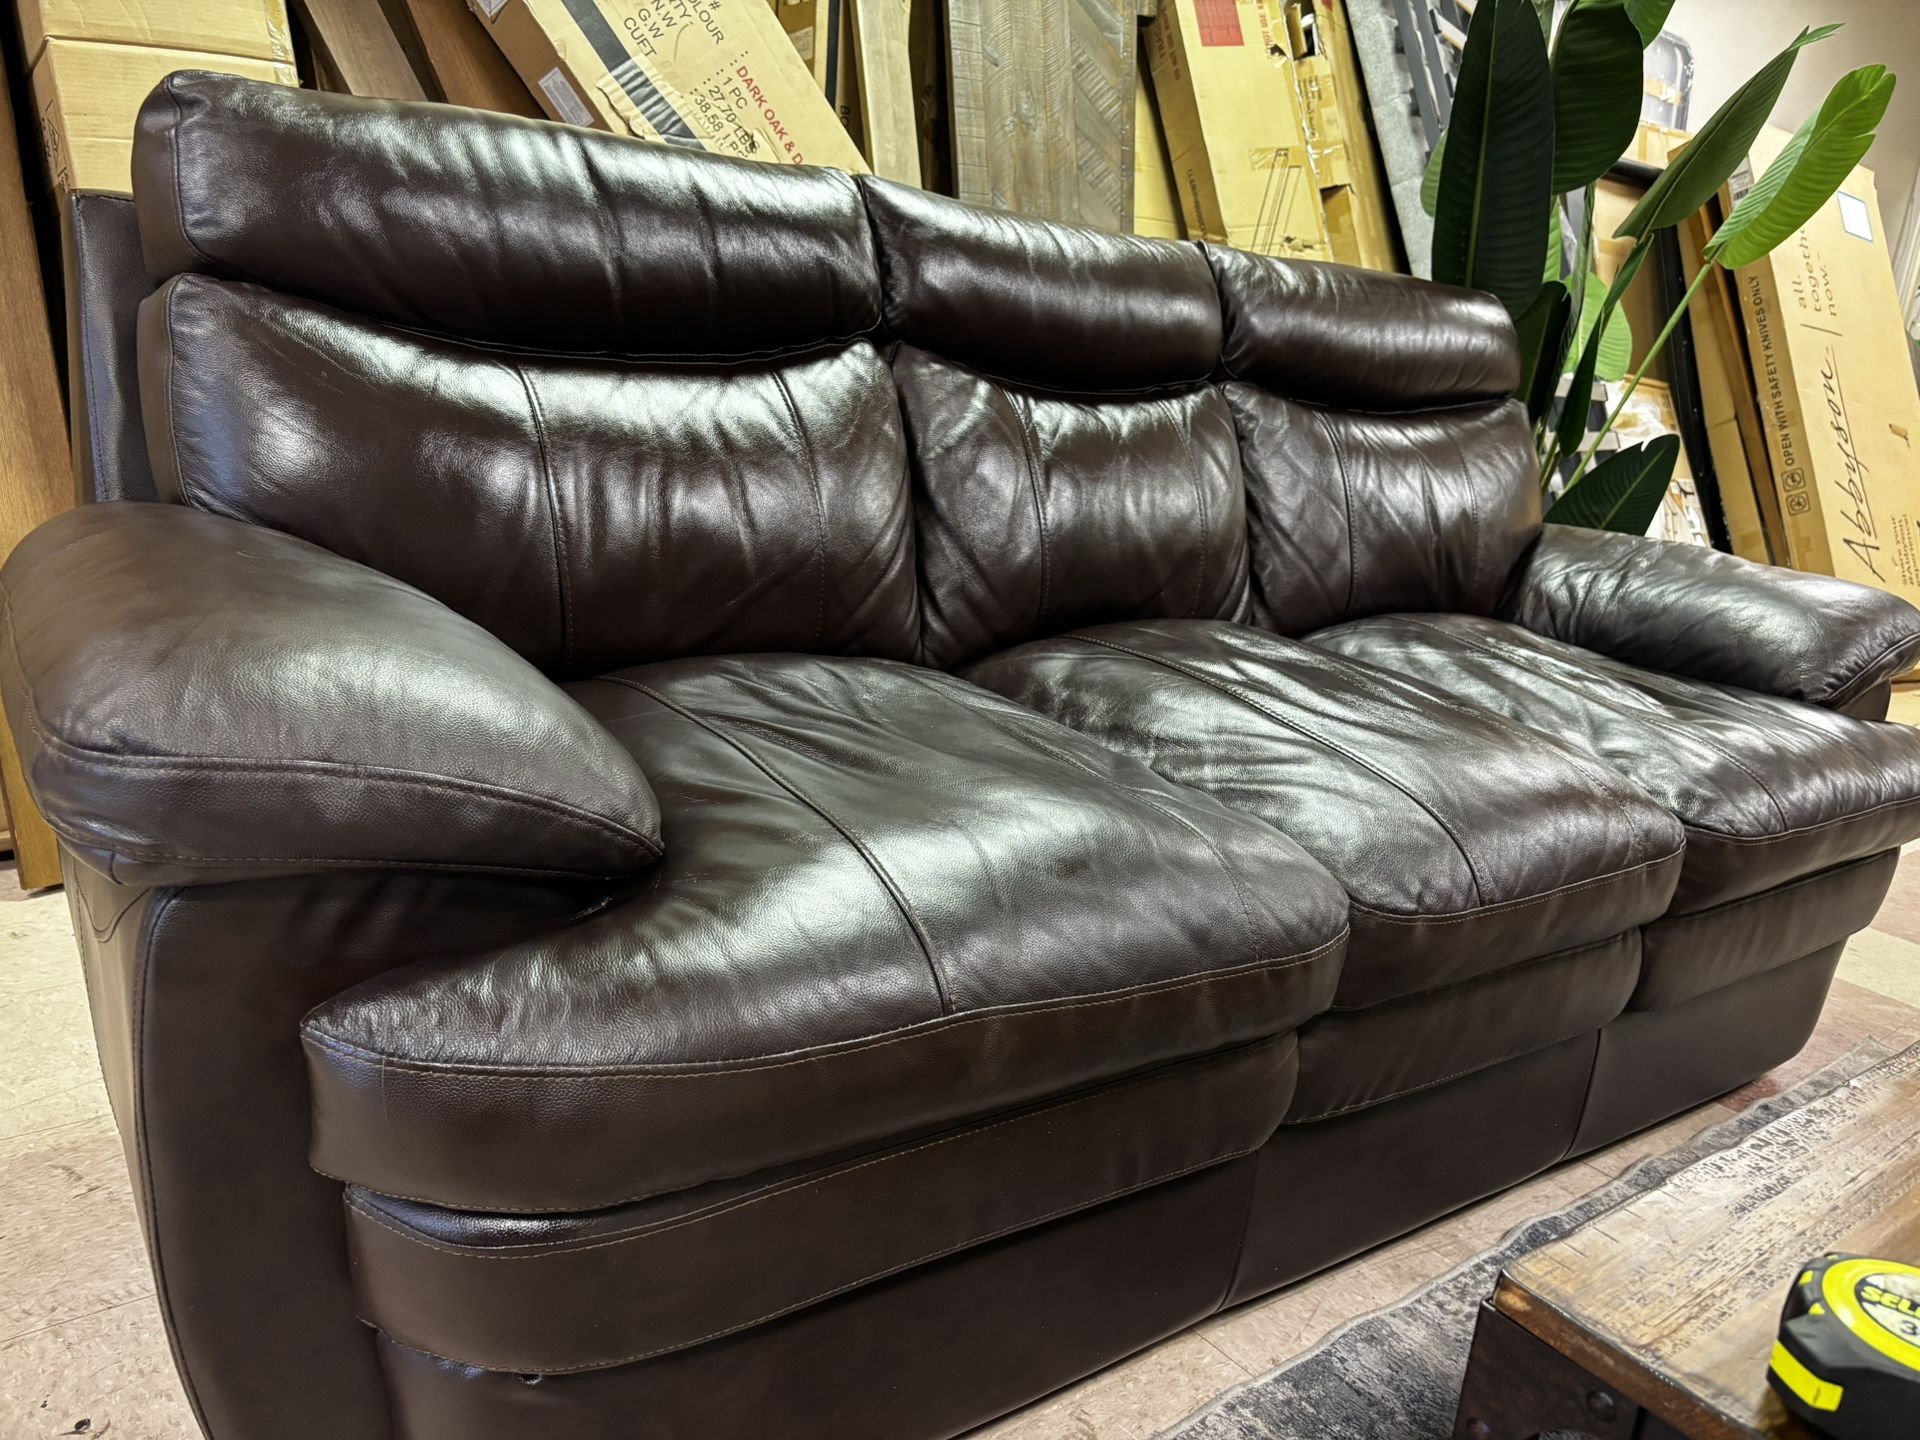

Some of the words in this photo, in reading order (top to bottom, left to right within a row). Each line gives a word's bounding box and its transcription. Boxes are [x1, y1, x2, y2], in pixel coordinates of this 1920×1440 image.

[651, 0, 678, 28] N.W
[624, 17, 657, 57] CUFT
[669, 0, 692, 19] TY
[723, 77, 733, 86] 1
[729, 87, 748, 110] PC
[638, 8, 664, 39] G.W
[695, 95, 724, 132] 38.58
[688, 0, 725, 45] LOUR
[736, 66, 768, 109] DARK
[764, 108, 788, 140] OAK
[784, 141, 795, 154] &
[1748, 276, 1763, 306] ONLY
[1755, 308, 1772, 351] KNIVES
[1763, 353, 1782, 400] SAFETY
[1772, 402, 1788, 431] WITH
[1781, 432, 1796, 467] OPEN
[1821, 355, 1886, 583] Abbyson
